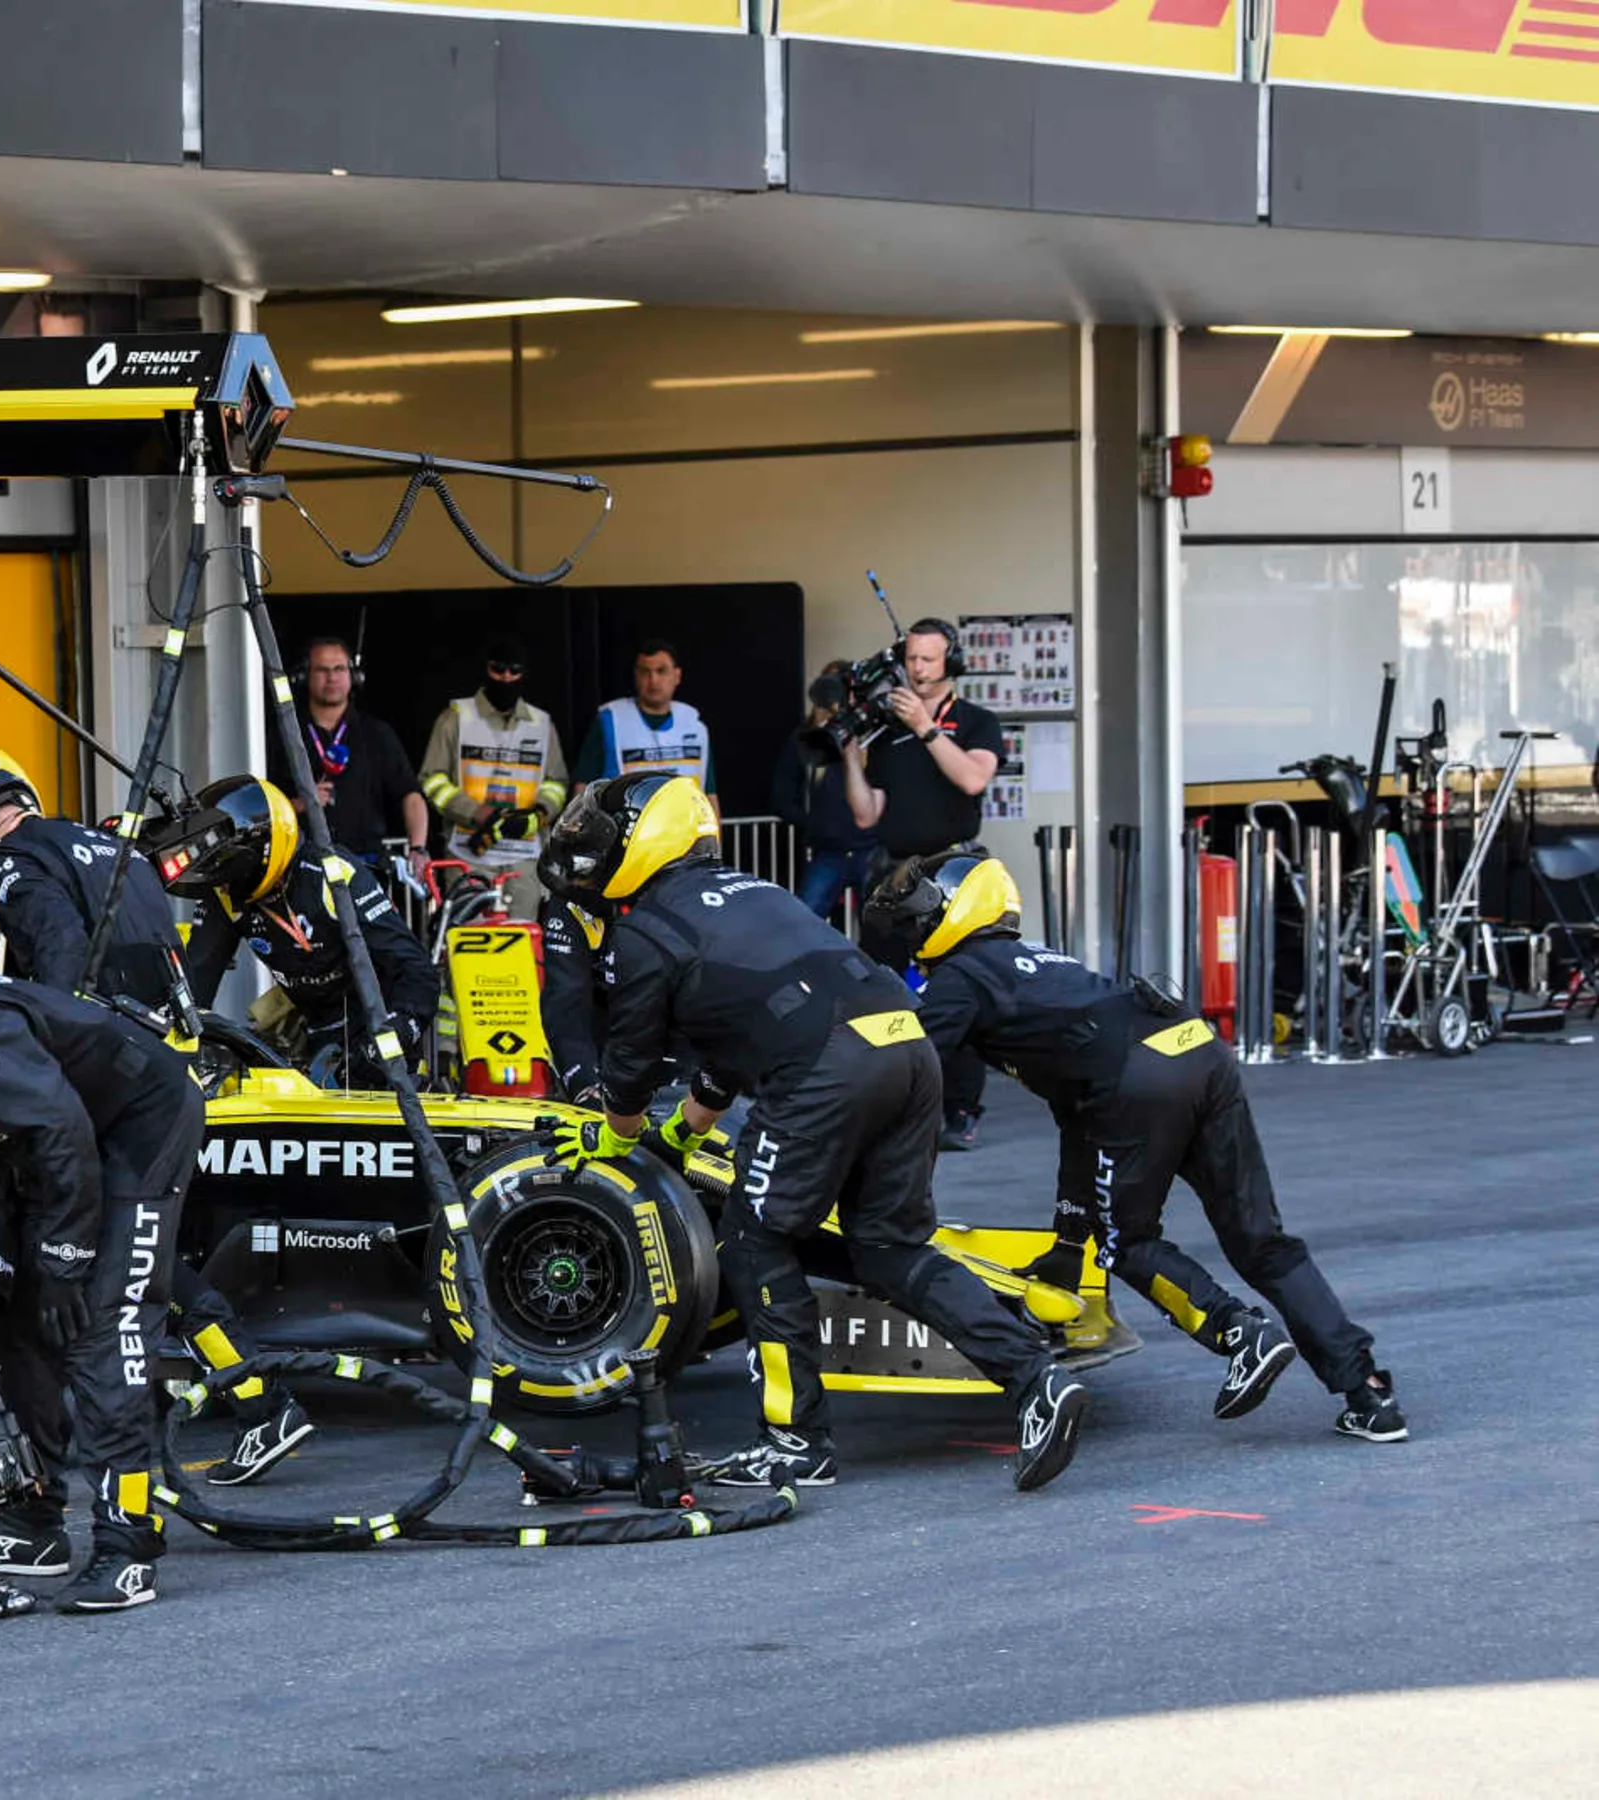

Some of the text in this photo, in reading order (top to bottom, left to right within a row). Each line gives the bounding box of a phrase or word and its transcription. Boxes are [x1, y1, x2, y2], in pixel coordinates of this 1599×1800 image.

[120, 365, 180, 375] F1 TEAM
[125, 350, 201, 364] RENAULT
[1469, 377, 1525, 407] Haas
[1411, 470, 1439, 510] 21
[454, 931, 526, 954] 27
[197, 1138, 415, 1178] MAPFRE
[284, 1229, 372, 1251] Microsoft
[631, 1200, 678, 1307] PIRELLI
[118, 1203, 161, 1387] RENAULT
